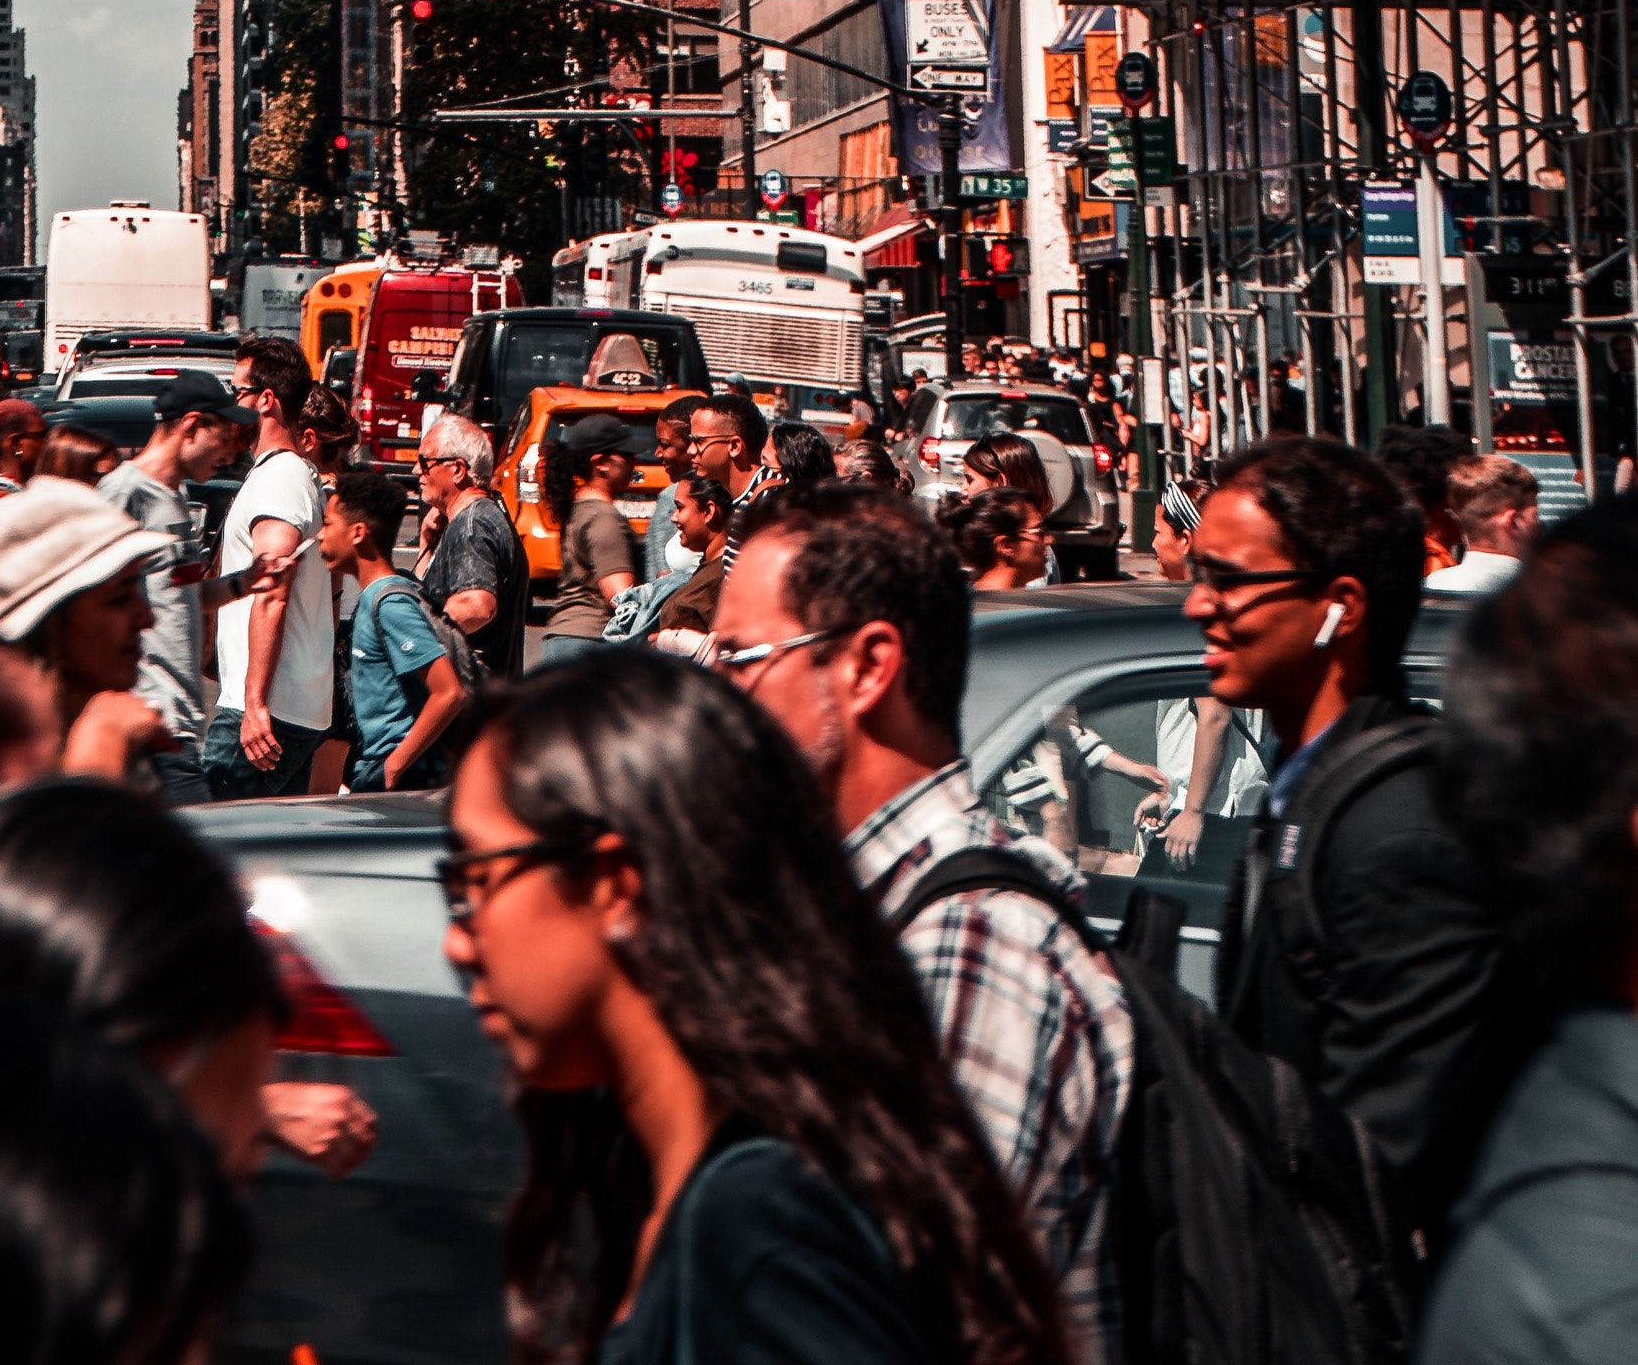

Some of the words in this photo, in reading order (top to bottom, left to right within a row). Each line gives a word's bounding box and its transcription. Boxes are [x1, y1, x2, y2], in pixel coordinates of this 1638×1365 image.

[924, 2, 969, 16] BUSES
[929, 25, 965, 38] ONLY
[1089, 43, 1116, 93] Pax
[920, 71, 942, 83] ONE
[954, 73, 979, 83] WAY
[1048, 57, 1073, 106] Pax
[992, 178, 1012, 193] 35
[738, 279, 773, 295] 3465
